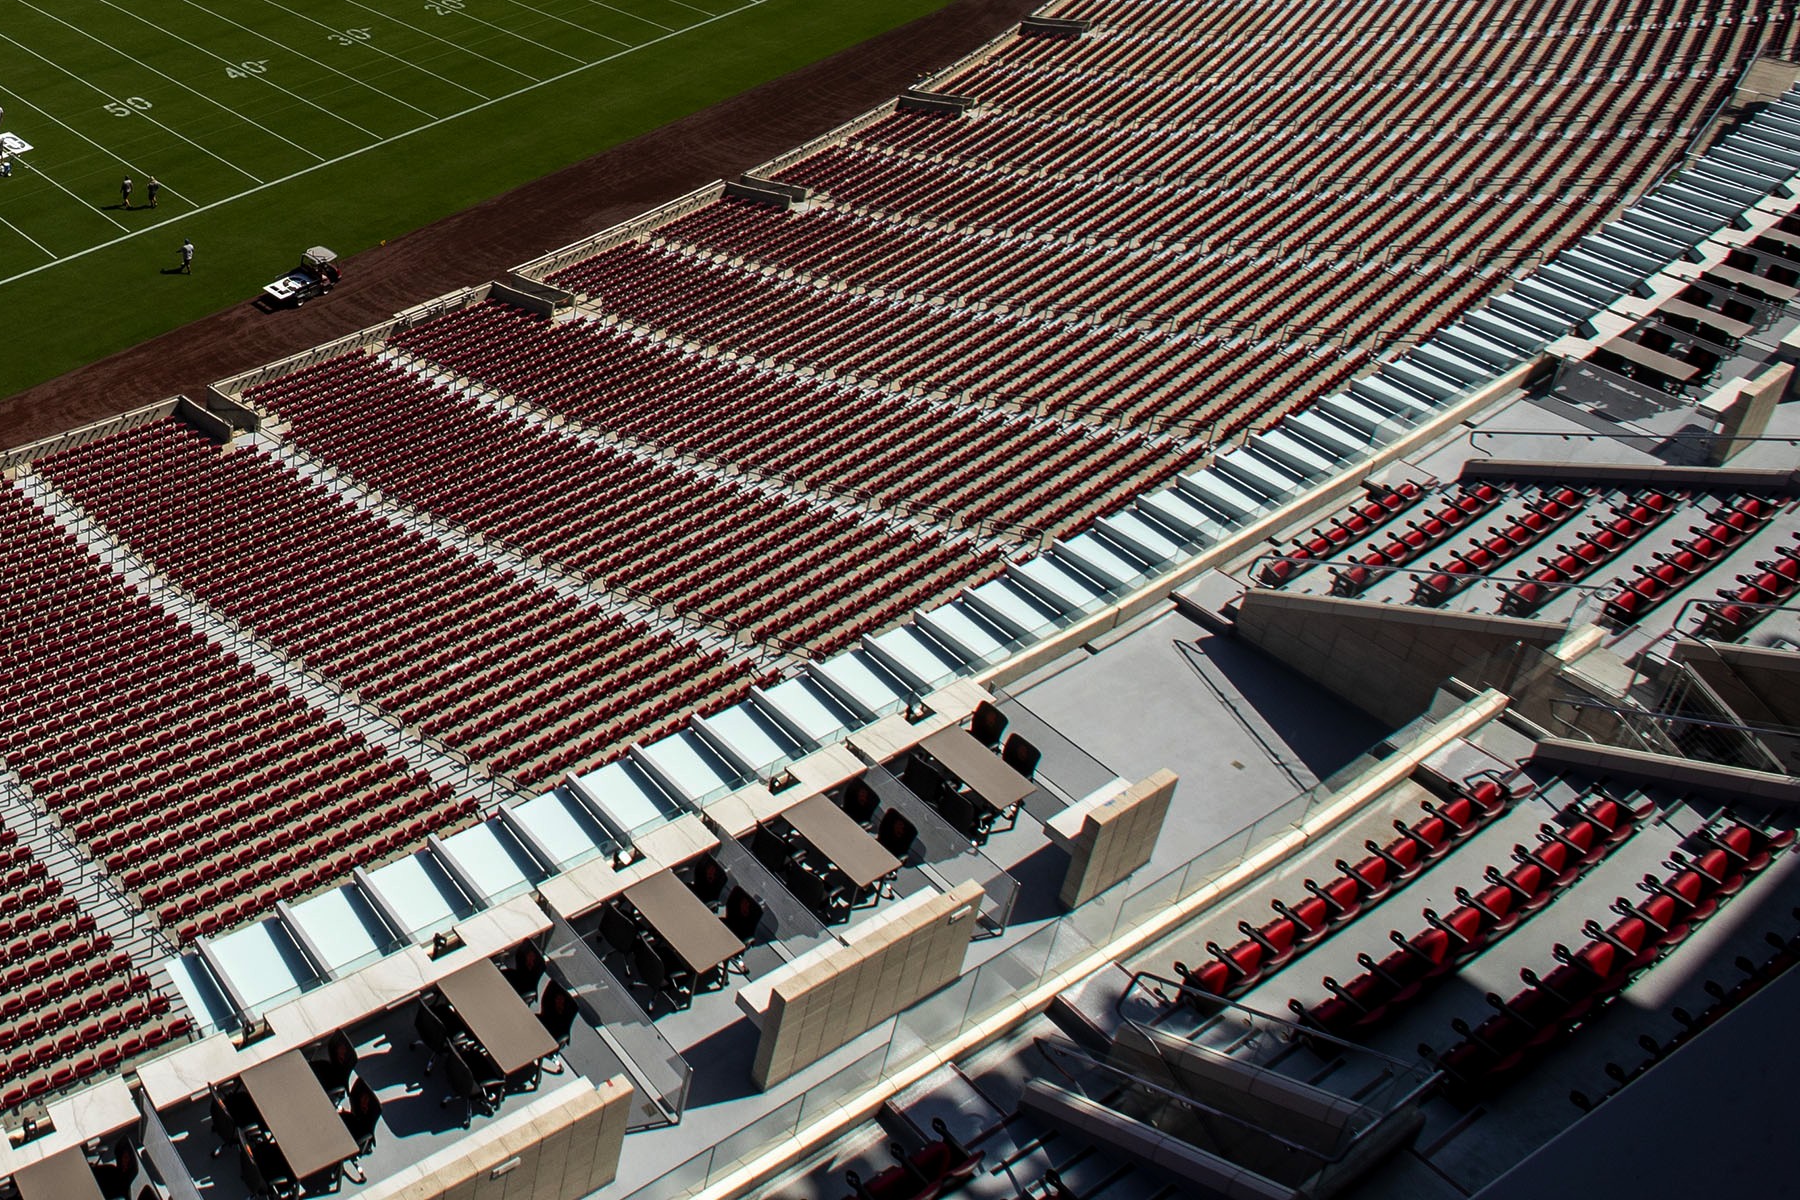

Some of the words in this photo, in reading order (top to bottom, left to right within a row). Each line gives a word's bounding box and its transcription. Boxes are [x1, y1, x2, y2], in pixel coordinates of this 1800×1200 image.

[424, 0, 466, 15] 20
[327, 29, 371, 46] 30
[225, 61, 267, 78] 40
[103, 97, 153, 117] 50
